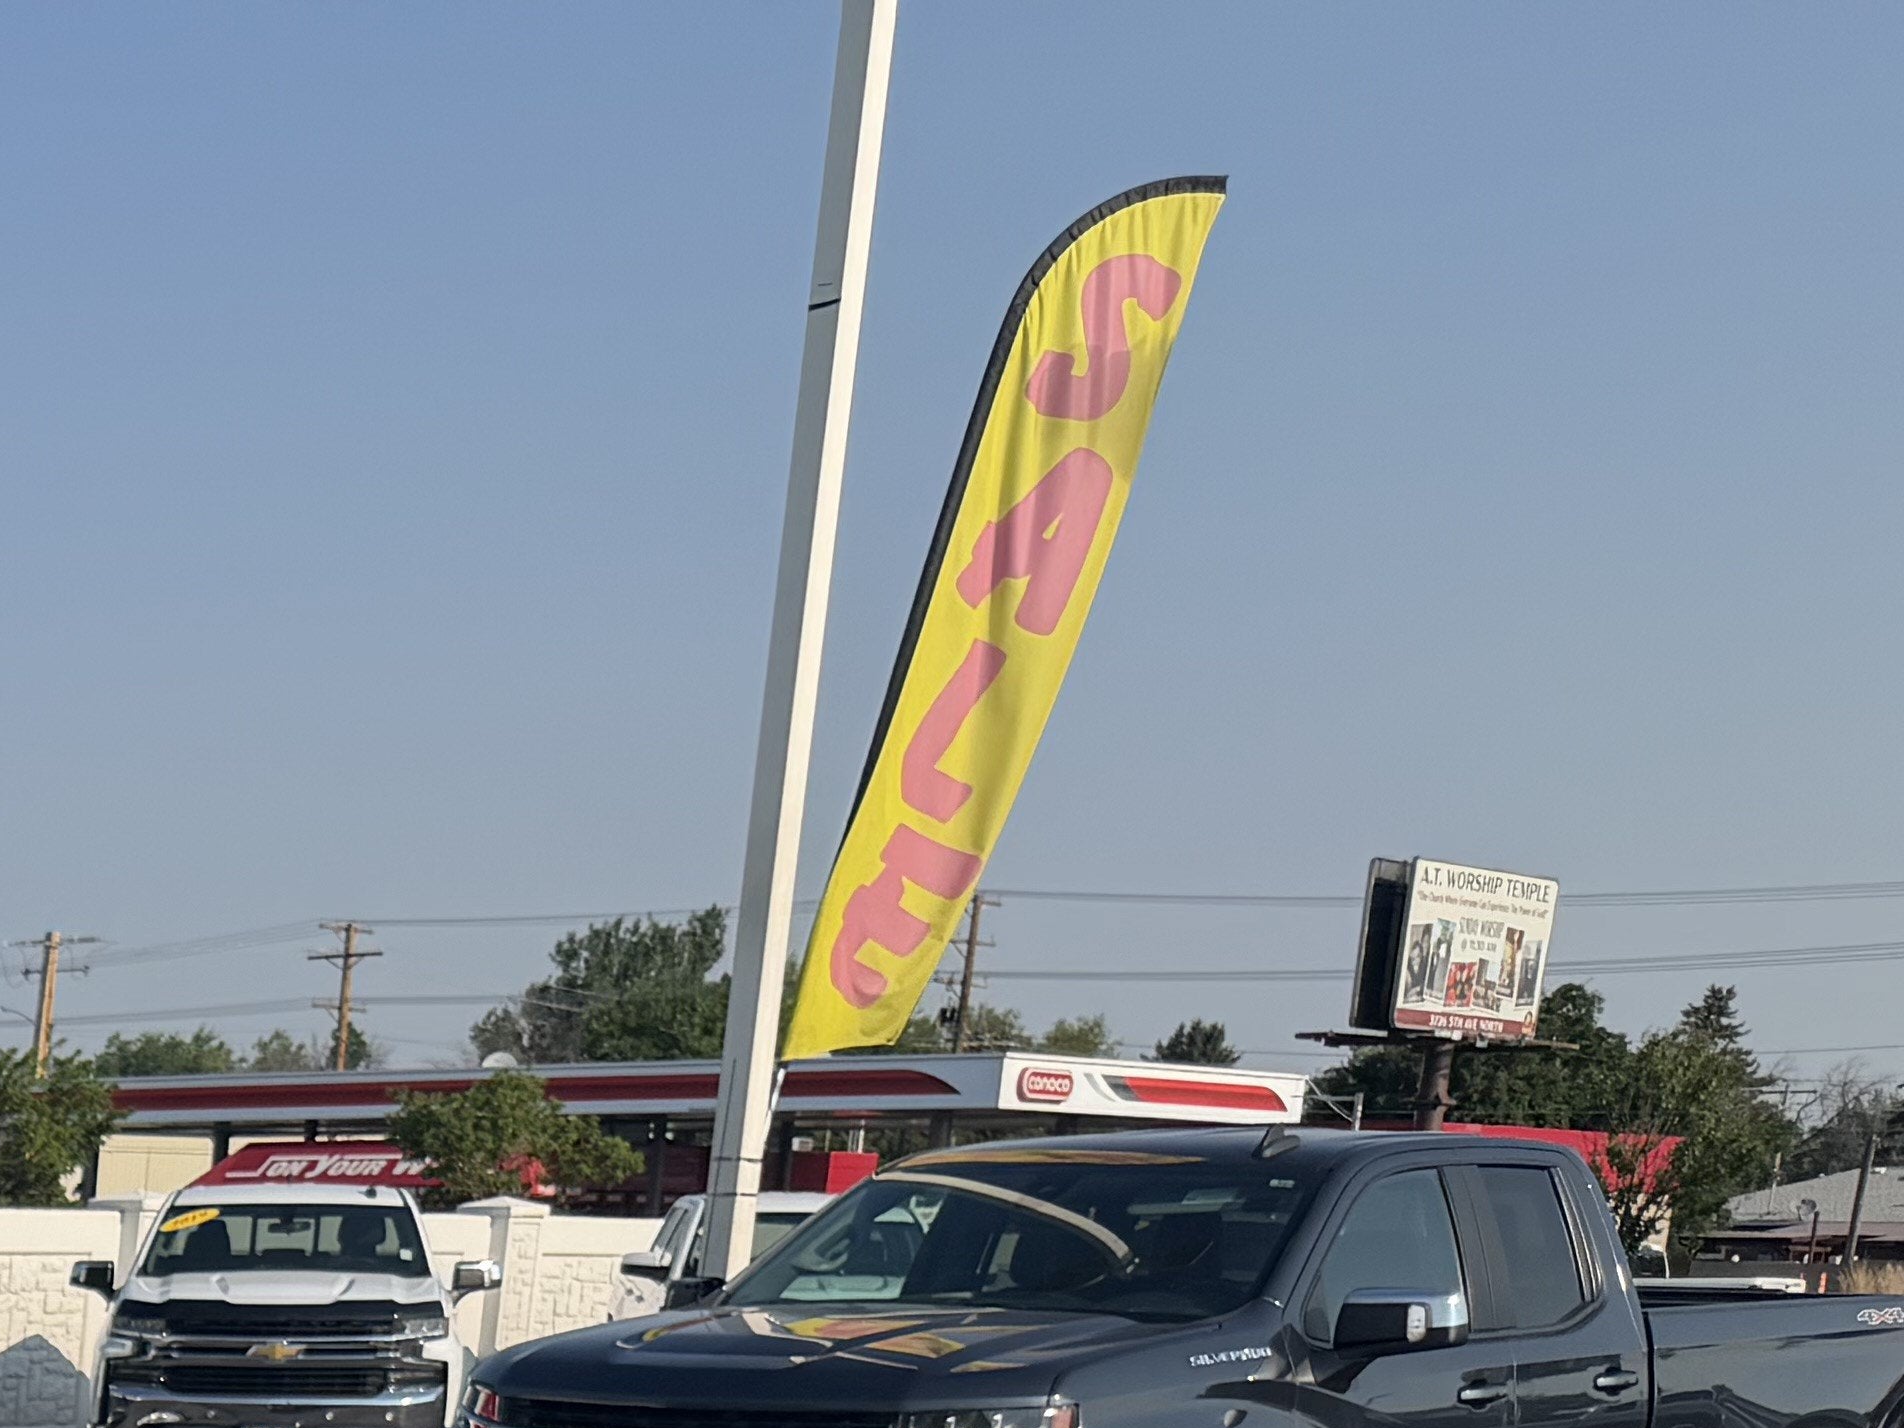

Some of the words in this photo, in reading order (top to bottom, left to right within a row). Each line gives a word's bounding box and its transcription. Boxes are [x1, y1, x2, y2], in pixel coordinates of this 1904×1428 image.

[830, 253, 1181, 1010] SALE
[1447, 869, 1503, 895] WORSHIP
[1506, 878, 1551, 903] TEMPLE
